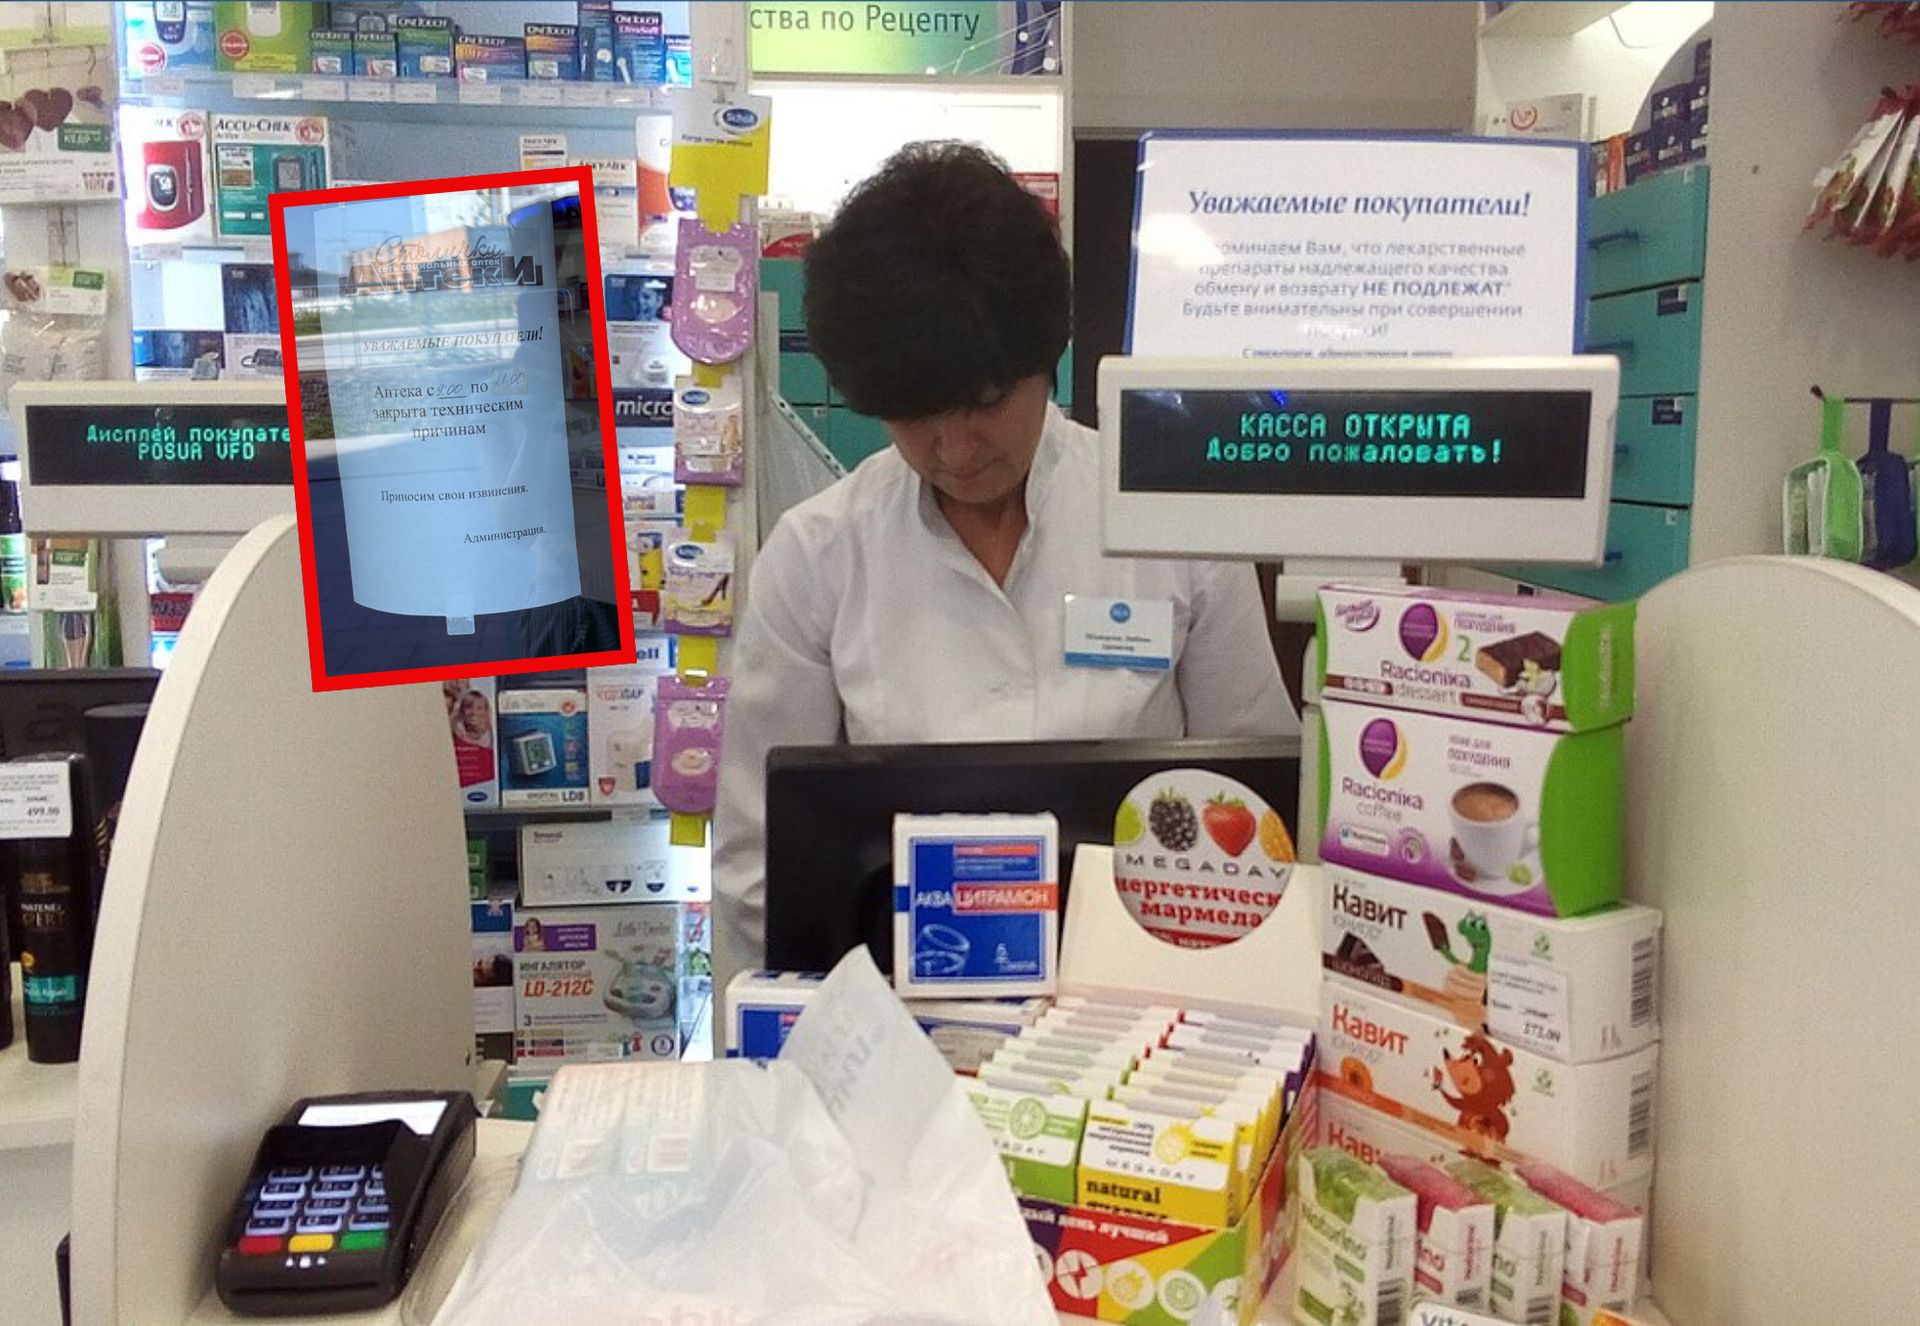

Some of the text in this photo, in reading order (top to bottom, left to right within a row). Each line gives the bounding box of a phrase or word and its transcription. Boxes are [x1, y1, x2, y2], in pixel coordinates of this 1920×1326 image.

[822, 12, 854, 31] по
[866, 5, 980, 40] Рецепту
[1188, 190, 1531, 223] Уважаемые покупатели!
[1351, 243, 1381, 257] что
[1385, 243, 1526, 258] лекарственные
[1300, 263, 1424, 279] надлежащего
[1428, 263, 1509, 277] качества
[1194, 281, 1260, 299] обмену
[1264, 284, 1276, 296] и
[1280, 284, 1359, 300] возврату
[1362, 281, 1389, 297] НЕ
[1182, 302, 1523, 320] Будьте внимательны при совершении
[364, 326, 544, 352] УВАЖАЕМЫЕ ПОКУПАТЕЛИ!
[374, 386, 422, 399] Аптека
[427, 387, 435, 396] с
[470, 383, 489, 394] по
[372, 400, 524, 422] закрыта техническим
[86, 424, 176, 444] Дисплей
[413, 424, 487, 441] причинам
[1240, 413, 1471, 439] КАССА ОТКРЫТА
[216, 442, 256, 460] VFD
[1206, 436, 1502, 465] Добро пожаловать!
[381, 484, 529, 504] Приносим свои извинения.
[464, 526, 547, 544] Администрация.
[1457, 634, 1472, 662] 2
[1380, 660, 1471, 689] Racionika
[1341, 776, 1424, 811] Racionika
[1126, 853, 1286, 880] MEGADAY
[1333, 883, 1408, 931] Кавит
[524, 979, 594, 997] LD-212C
[1332, 1004, 1410, 1055] Кавит
[1086, 1179, 1161, 1205] natural
